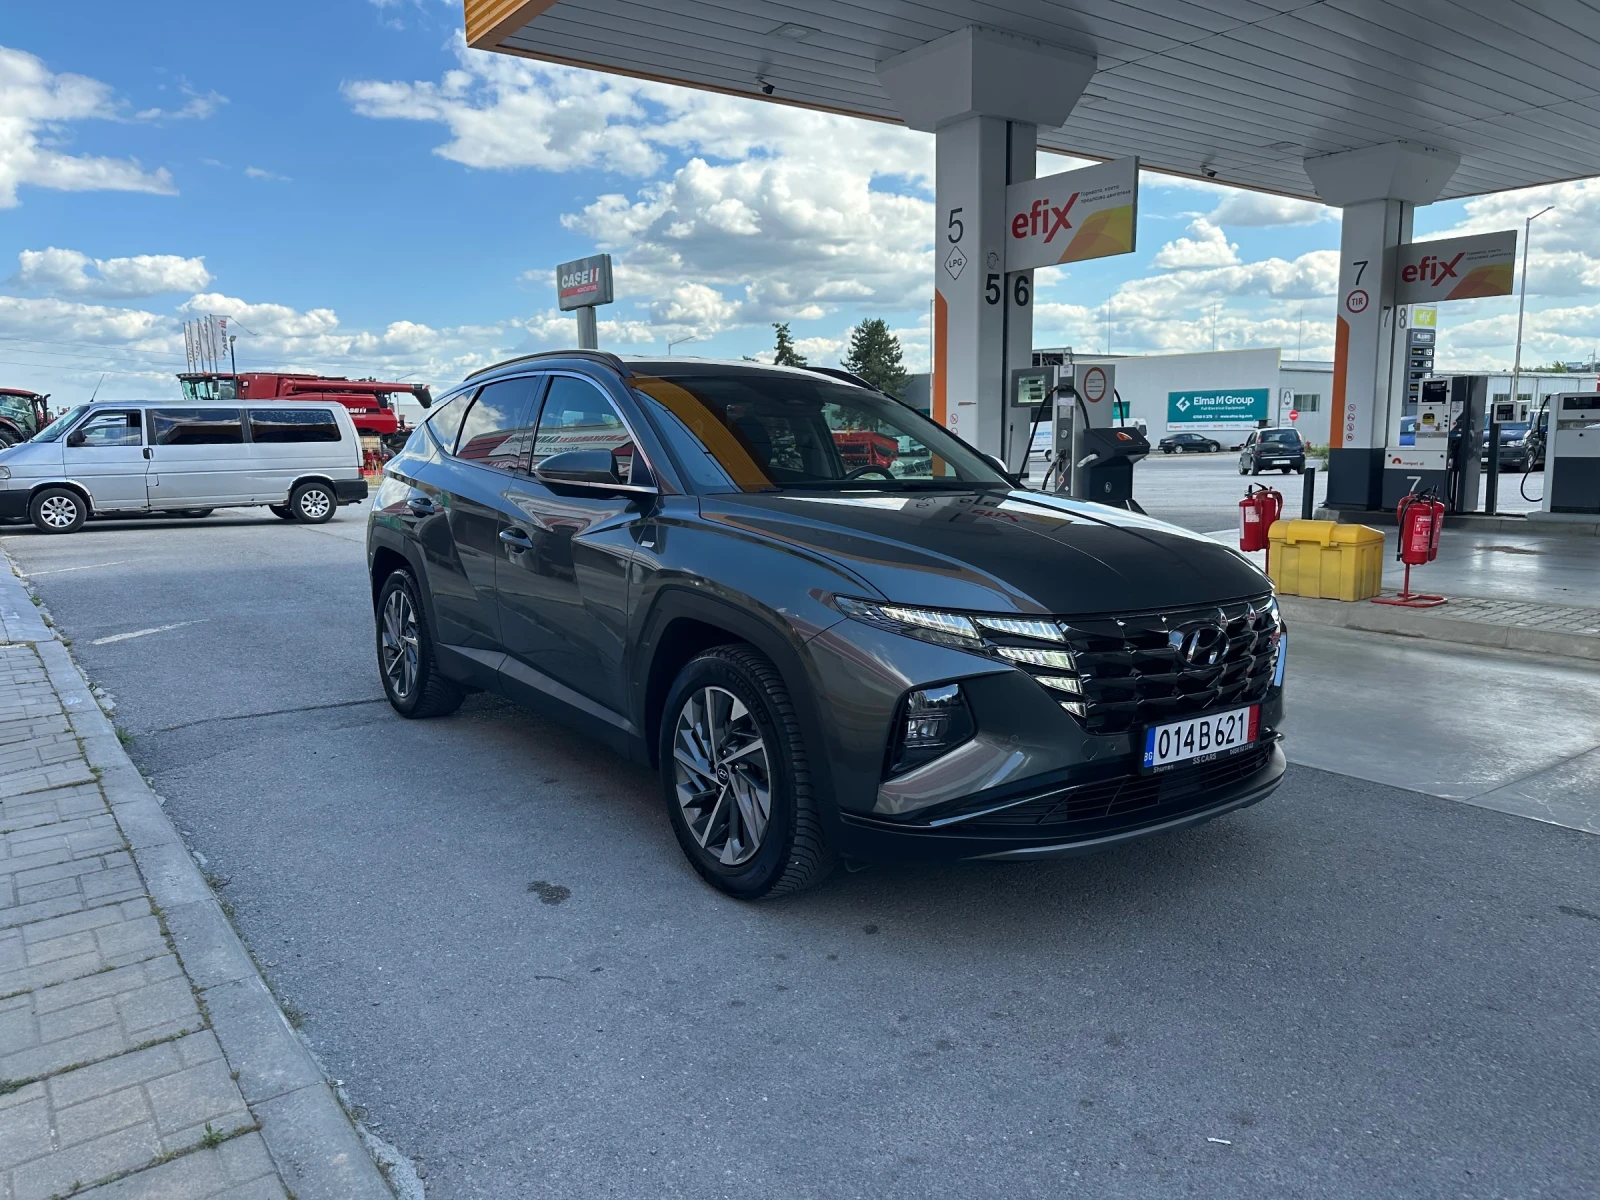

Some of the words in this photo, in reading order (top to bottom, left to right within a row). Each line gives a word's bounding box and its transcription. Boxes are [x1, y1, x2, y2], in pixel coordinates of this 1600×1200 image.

[947, 207, 964, 244] 5
[1011, 192, 1080, 243] efix
[948, 257, 963, 268] LPG
[1353, 260, 1369, 286] 7
[1401, 252, 1466, 287] efix
[562, 271, 588, 288] CASE
[985, 273, 1001, 305] 5
[1013, 275, 1030, 307] 6
[1351, 297, 1364, 306] TIR
[1382, 306, 1392, 328] 7
[1399, 307, 1407, 329] 8
[1193, 396, 1215, 405] Elma
[1215, 396, 1225, 405] M
[1225, 395, 1254, 406] Group
[1406, 475, 1422, 494] 7
[1144, 752, 1154, 762] BG
[1153, 764, 1174, 774] Shumen
[1201, 753, 1217, 762] CARS
